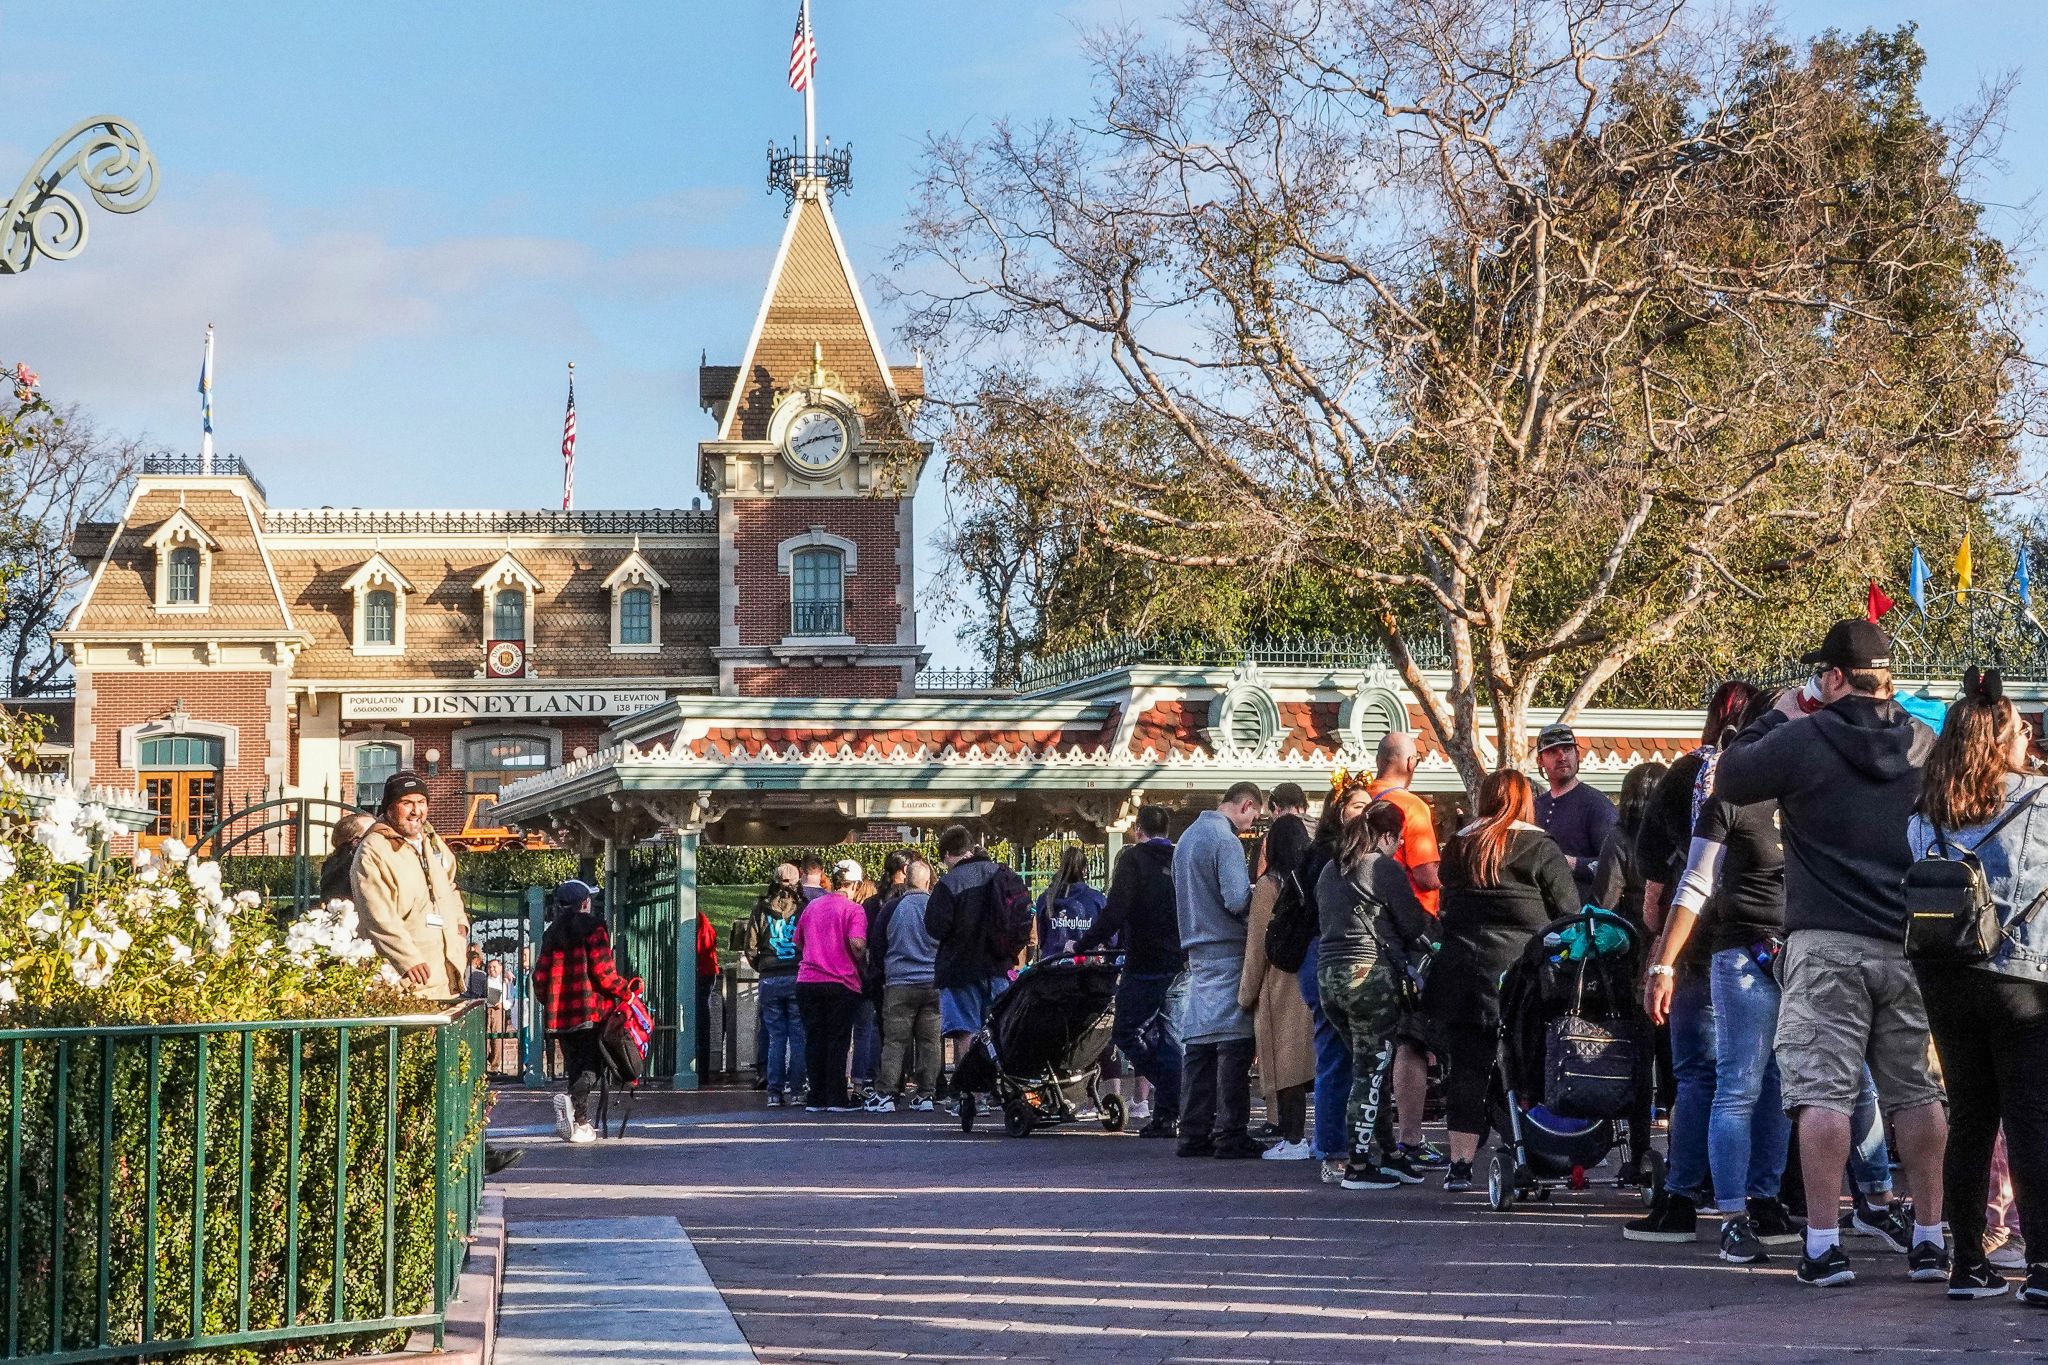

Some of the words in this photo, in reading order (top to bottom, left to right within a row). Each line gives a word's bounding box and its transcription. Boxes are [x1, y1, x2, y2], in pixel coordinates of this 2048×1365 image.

[350, 696, 404, 705] POPULATION
[613, 694, 660, 702] ELEVATION
[412, 694, 607, 714] DISNEYLAND
[616, 704, 631, 712] 138
[901, 800, 936, 809] Entrance
[1050, 916, 1093, 930] Disneyland
